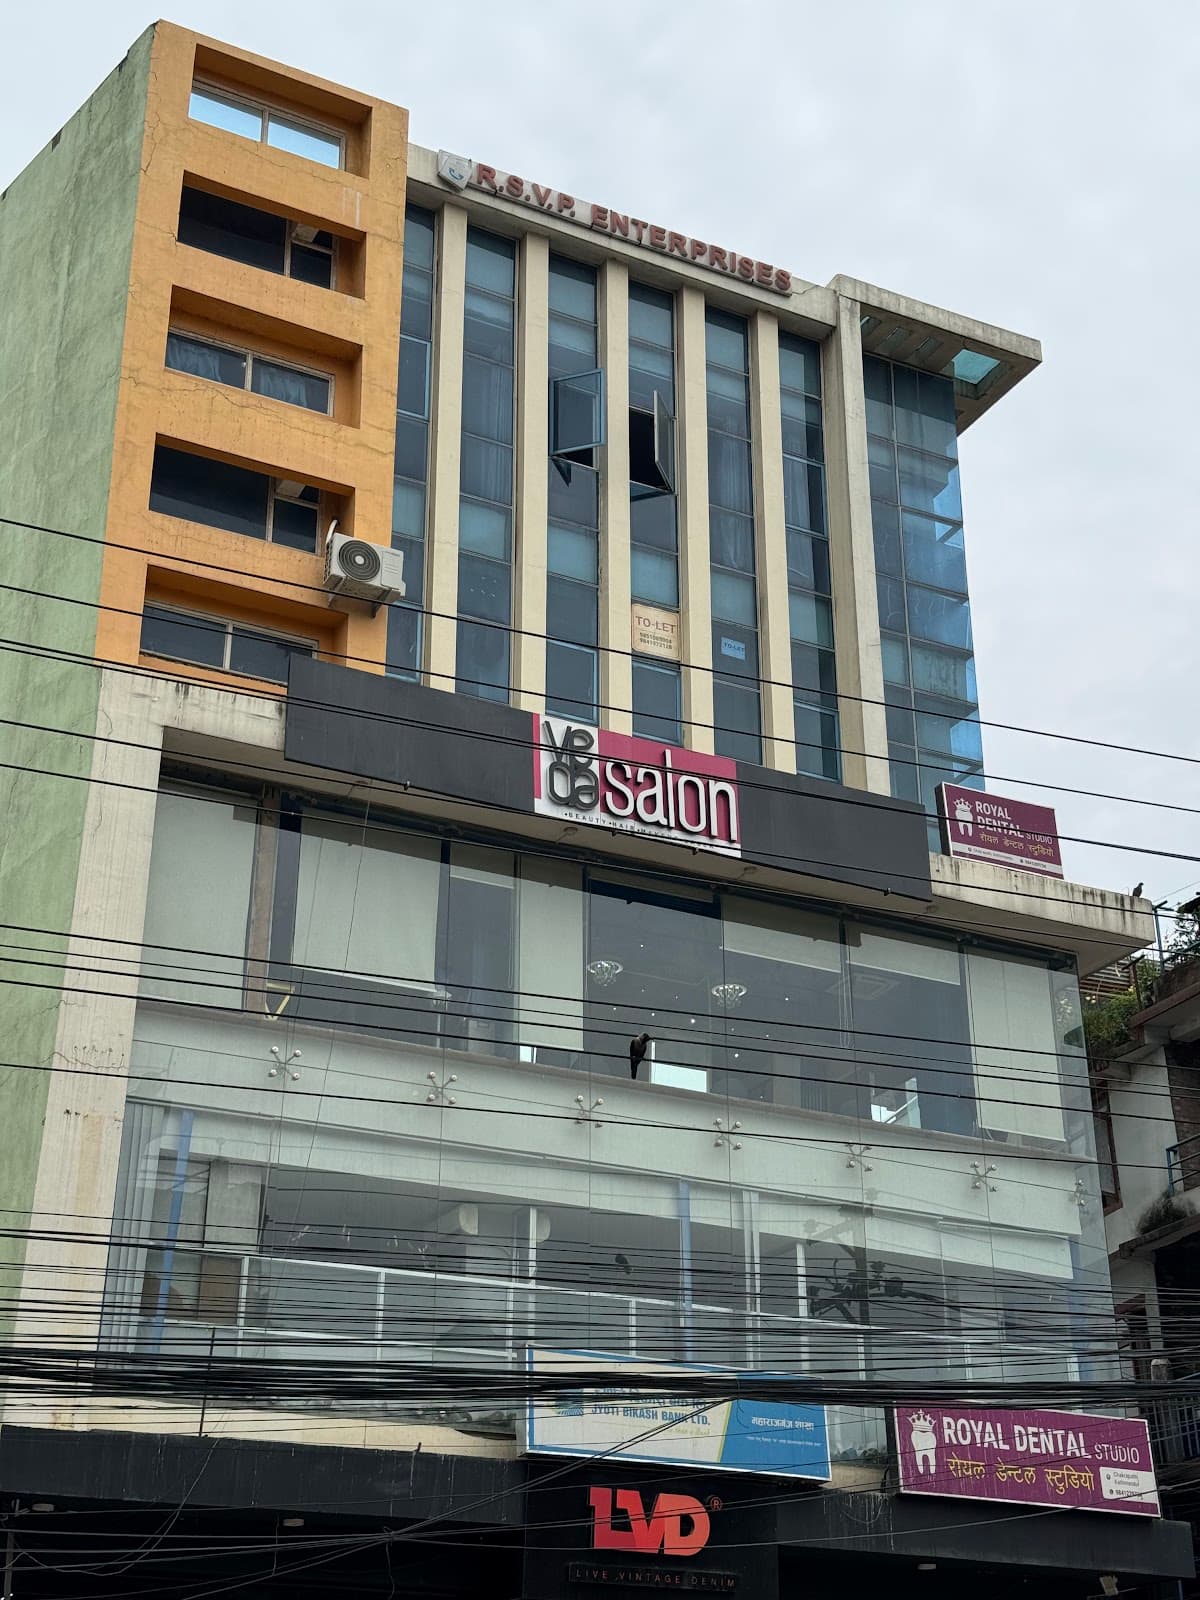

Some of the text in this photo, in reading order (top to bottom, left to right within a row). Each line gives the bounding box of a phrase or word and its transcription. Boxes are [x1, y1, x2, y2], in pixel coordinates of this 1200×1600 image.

[476, 163, 792, 291] R.S.V.P. ENTERPRISES
[635, 615, 677, 634] TO-LET
[604, 748, 738, 842] salon
[568, 812, 607, 825] BEAUTY
[975, 801, 1011, 820] ROYAL
[977, 816, 1053, 845] DENTAL STUDIO
[623, 1407, 658, 1421] BIKASH
[692, 1413, 711, 1426] LTD.
[943, 1416, 1140, 1464] ROYAL DENTAL STUDIO
[946, 1451, 1095, 1494] रोयल डेन्टल स्टुडियो
[589, 1486, 711, 1557] LVD
[576, 1570, 735, 1587] LIVE VINTAGE DENIM
